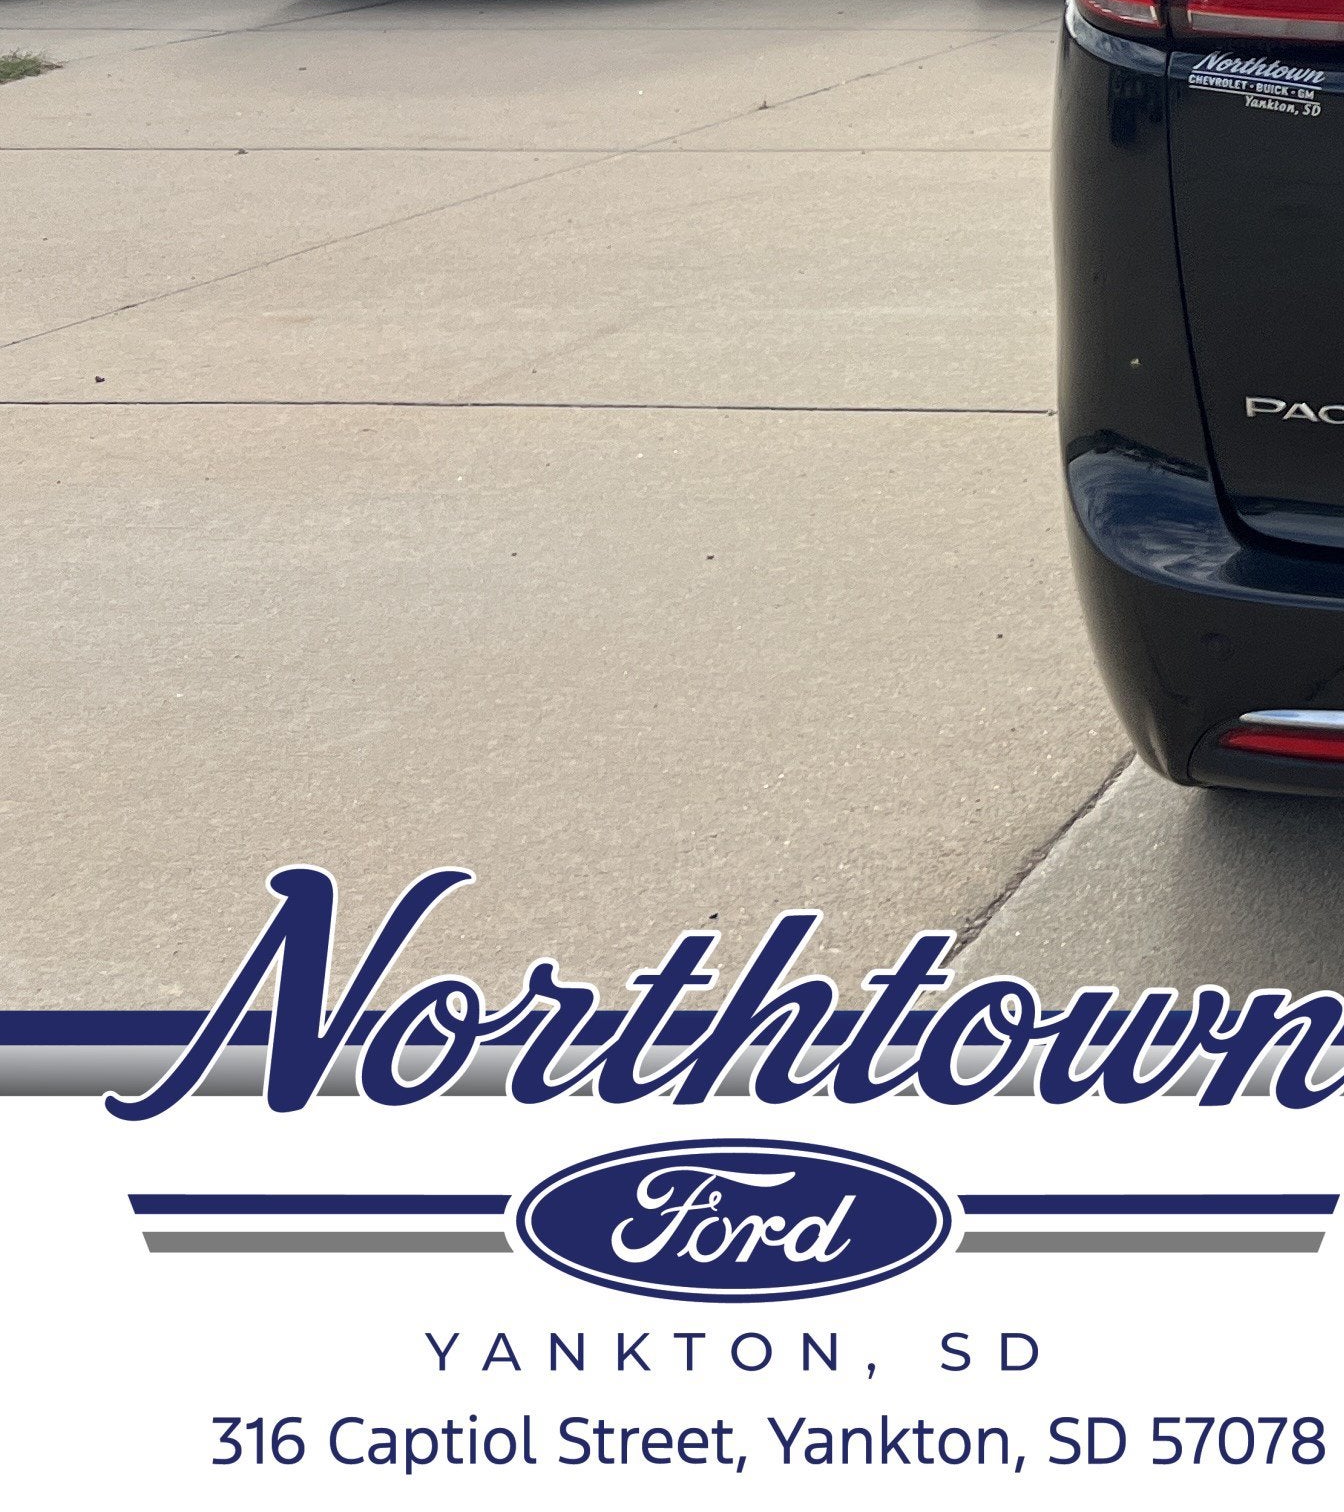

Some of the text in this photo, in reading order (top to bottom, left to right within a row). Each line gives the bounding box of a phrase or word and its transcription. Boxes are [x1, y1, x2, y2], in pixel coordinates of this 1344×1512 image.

[1191, 50, 1327, 85] Northtown
[1188, 74, 1248, 91] CHEVROLET
[1256, 83, 1289, 96] BUICK
[1244, 94, 1323, 117] Yankton, SD
